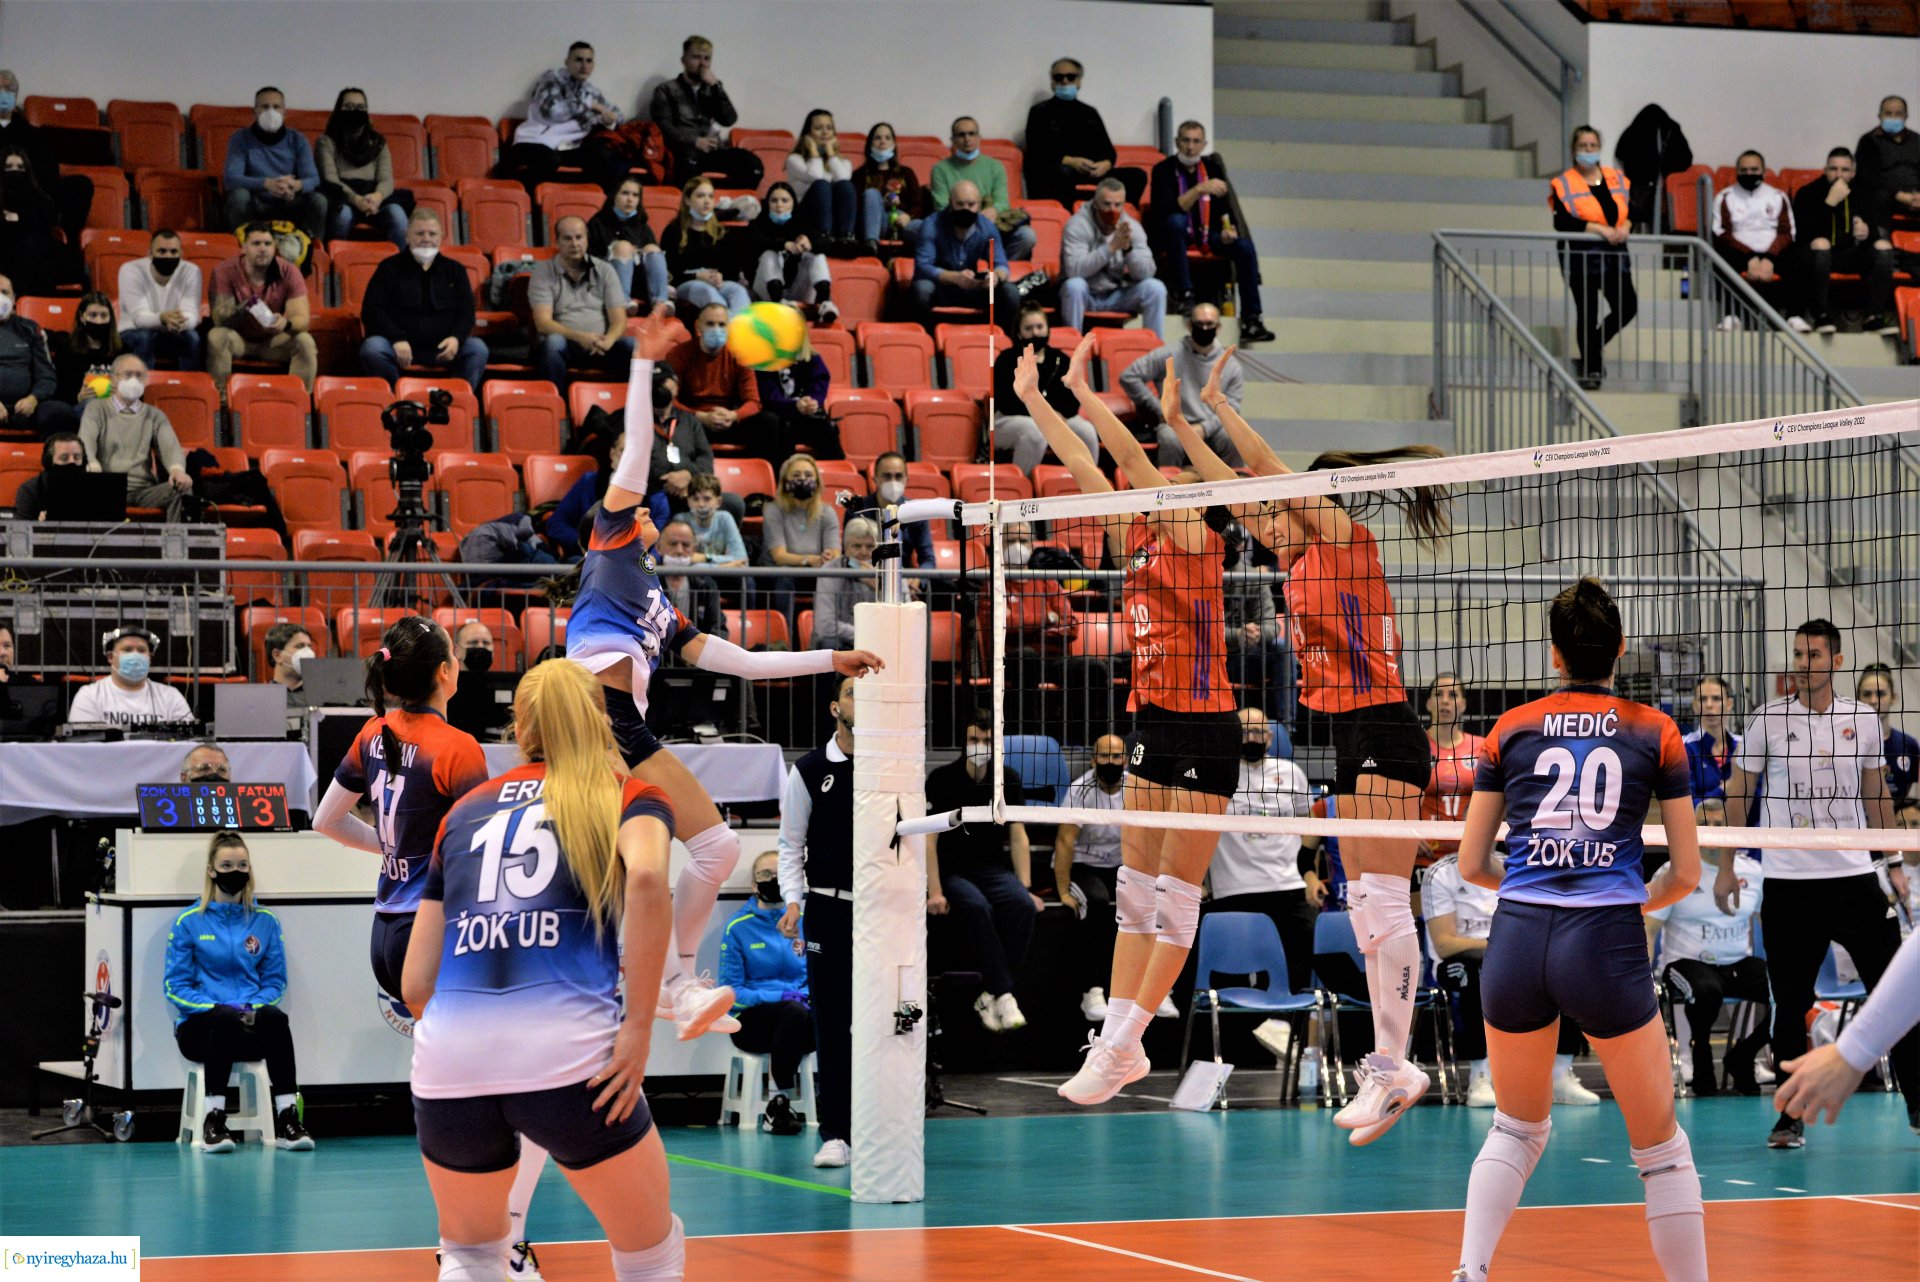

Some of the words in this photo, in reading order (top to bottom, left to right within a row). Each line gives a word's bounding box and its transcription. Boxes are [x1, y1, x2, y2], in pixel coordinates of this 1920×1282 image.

[1797, 423, 1821, 432] Champions
[1822, 421, 1838, 430] League
[1839, 419, 1853, 427] Volley
[1854, 417, 1866, 425] 2022
[1554, 453, 1574, 461] Champions
[1574, 451, 1588, 459] League
[1589, 449, 1600, 457] Volley
[1601, 447, 1610, 455] 2022
[1028, 504, 1039, 514] CEV
[1543, 708, 1619, 737] MEDIĆ
[369, 734, 418, 768] KEAN
[171, 786, 191, 797] UB
[237, 786, 285, 797] FATUM
[1530, 746, 1623, 831] 20
[156, 797, 179, 827] 3
[251, 797, 275, 827] 3
[371, 769, 406, 847] 17
[469, 803, 559, 903] 15
[1526, 833, 1576, 868] ŽOK
[1583, 840, 1617, 868] UB
[454, 910, 512, 957] ŽOK
[518, 910, 560, 948] UB
